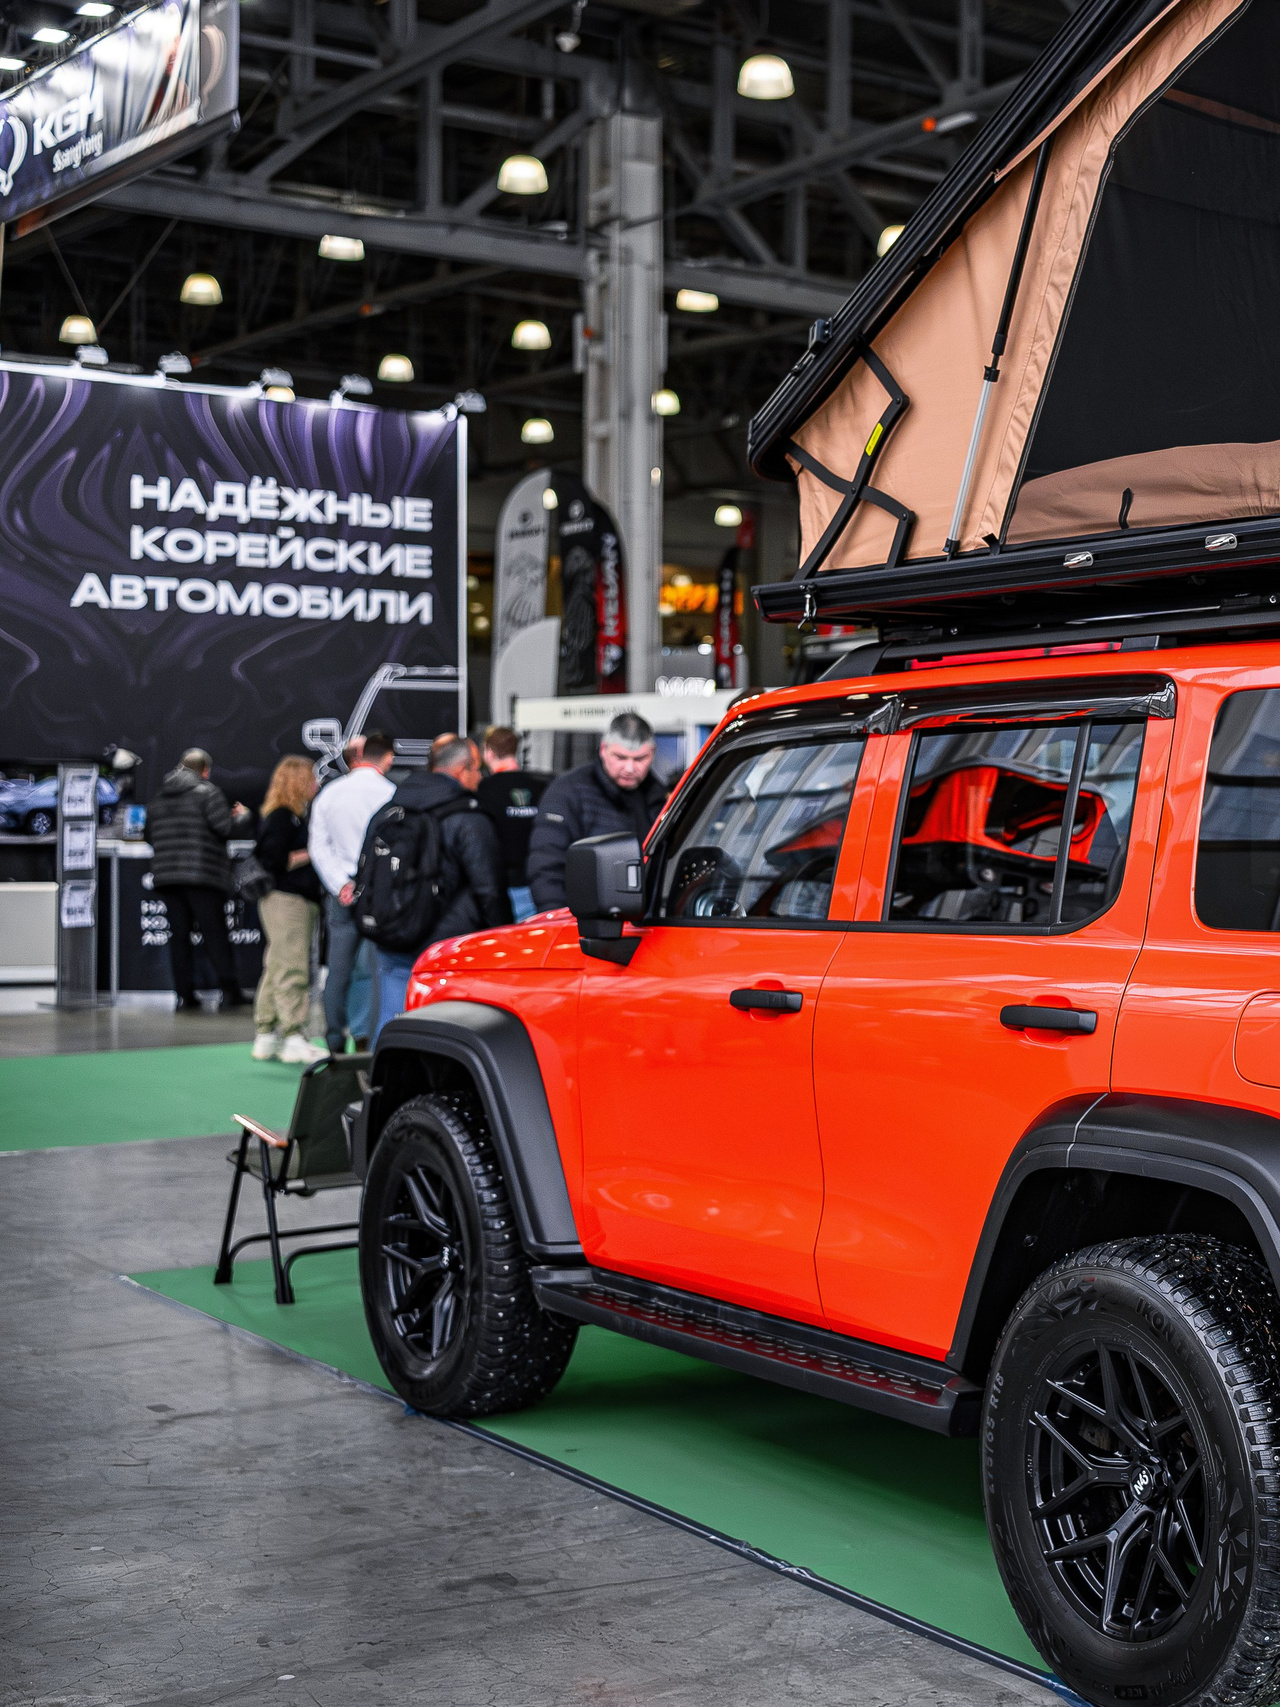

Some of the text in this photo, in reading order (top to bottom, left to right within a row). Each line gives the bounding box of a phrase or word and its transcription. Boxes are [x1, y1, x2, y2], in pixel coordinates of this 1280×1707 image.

[130, 473, 433, 532] НАДЁЖНЫЕ
[130, 524, 433, 579] КОРЕЙСКИЕ
[70, 572, 433, 626] АВТОМОБИЛИ
[990, 1372, 1004, 1409] R18
